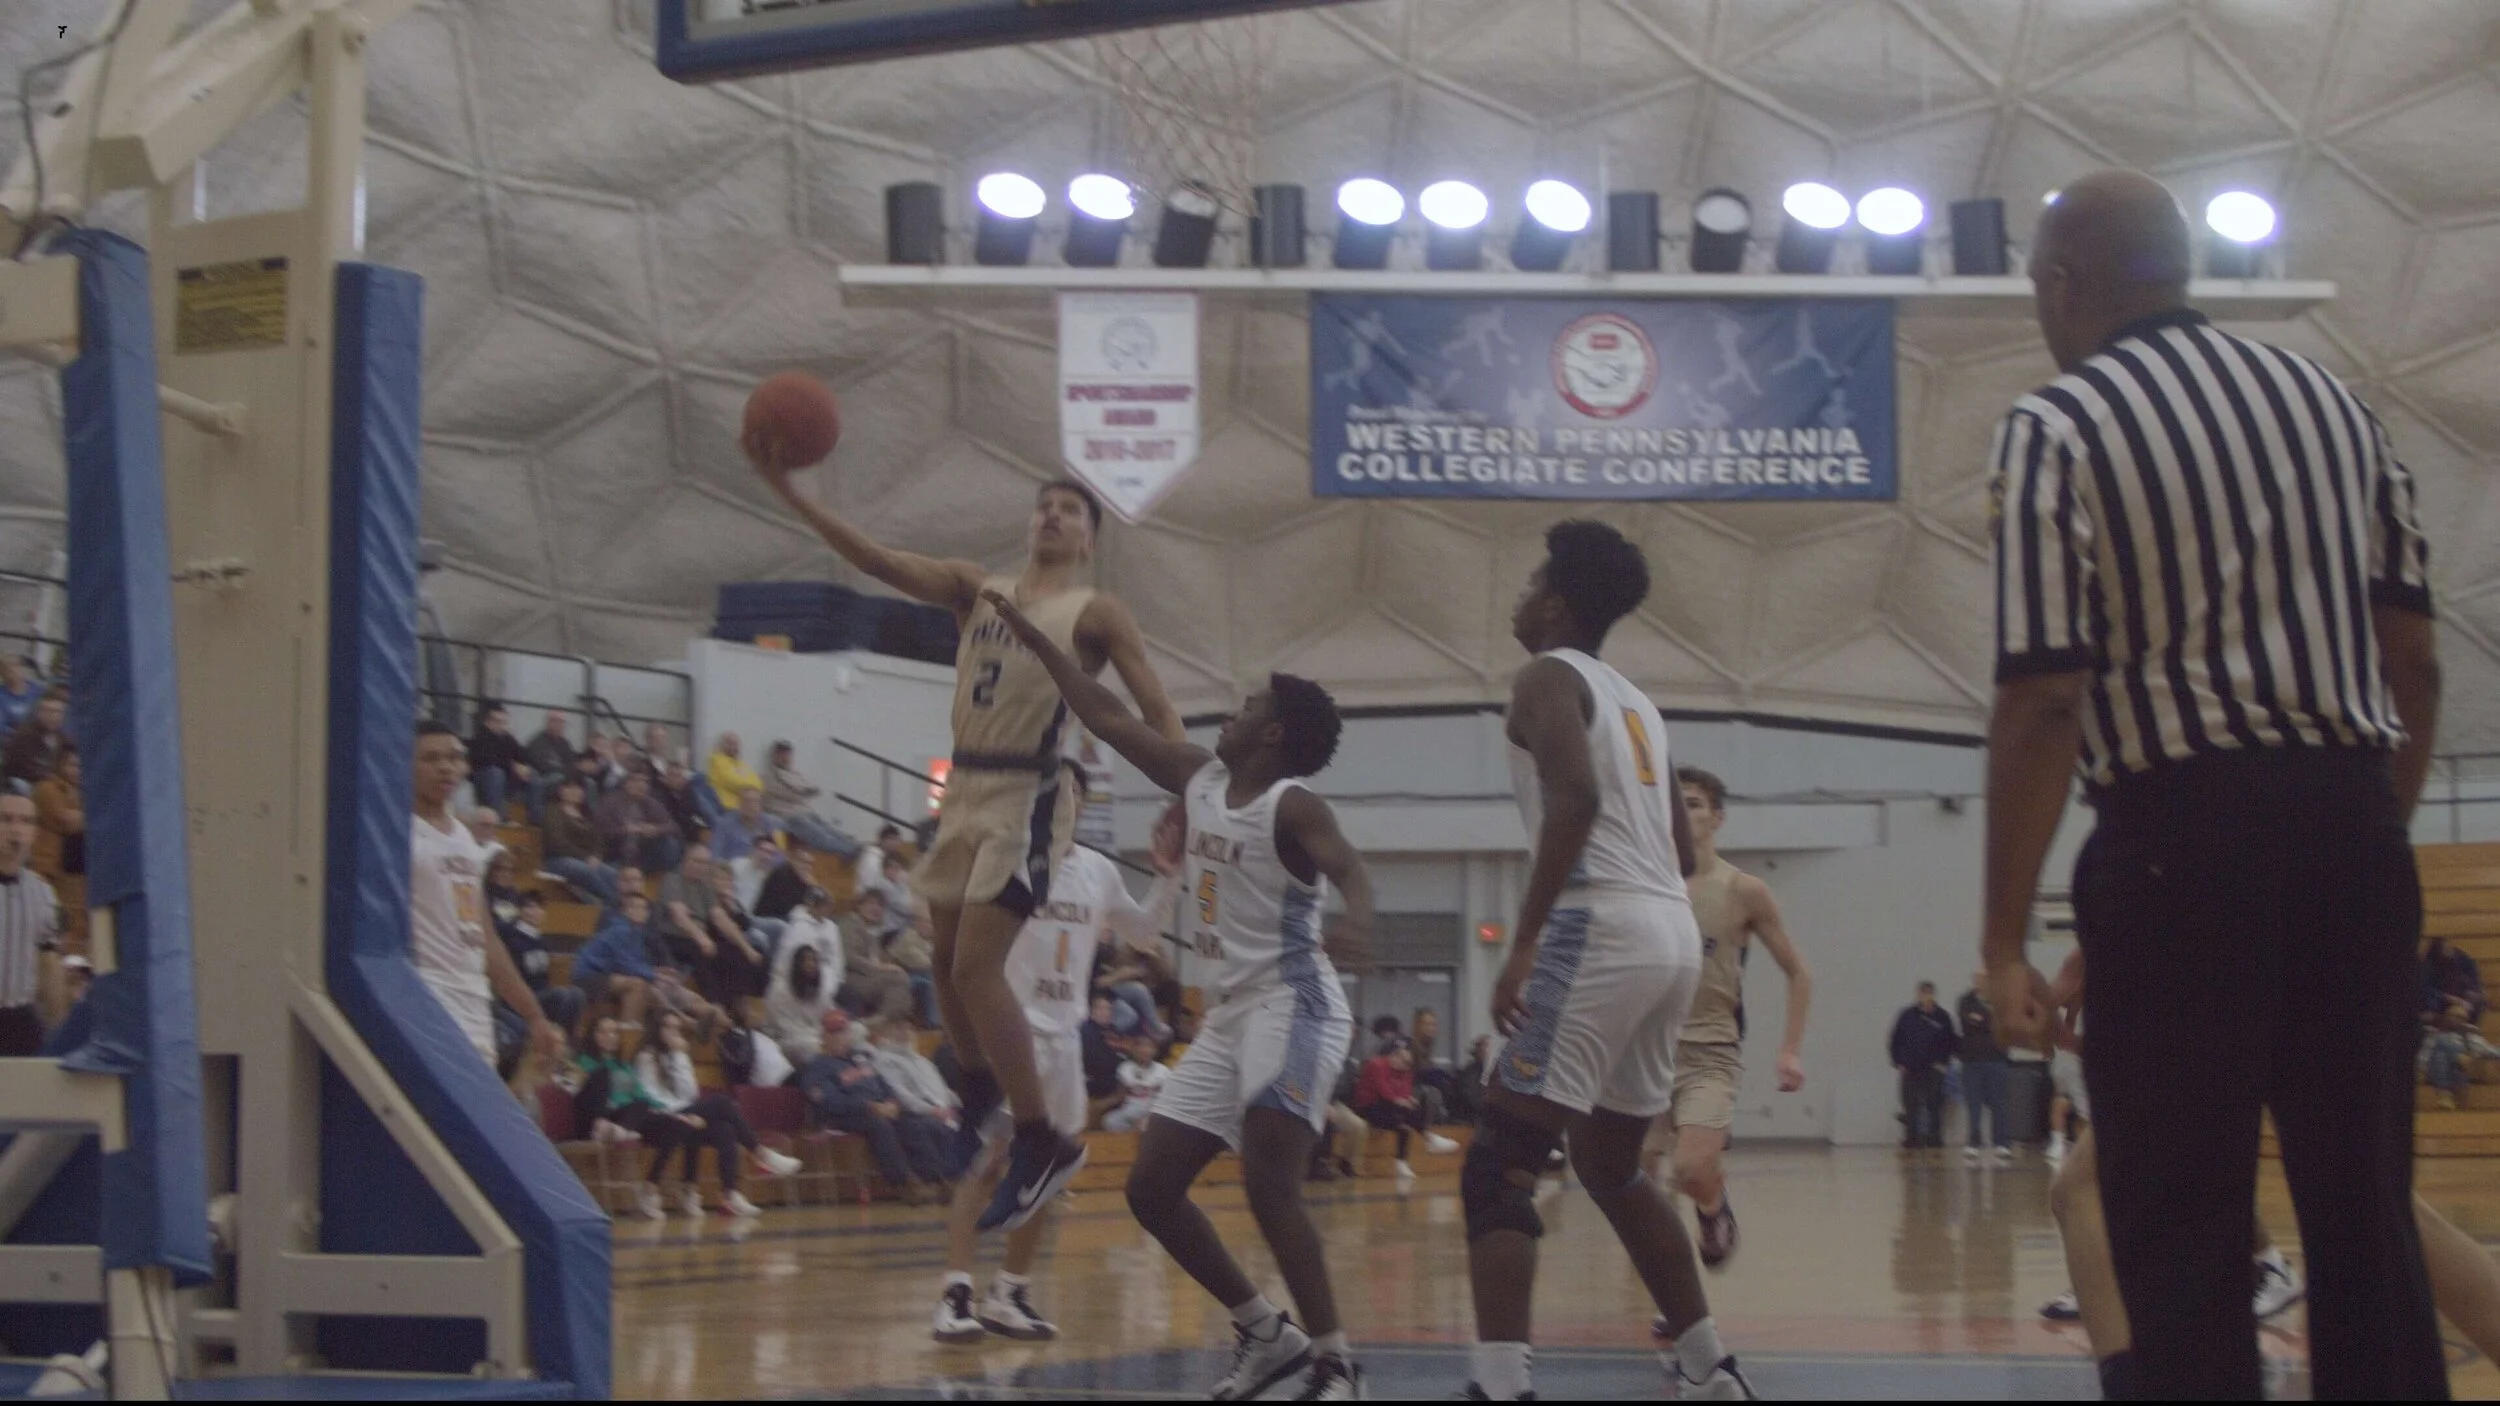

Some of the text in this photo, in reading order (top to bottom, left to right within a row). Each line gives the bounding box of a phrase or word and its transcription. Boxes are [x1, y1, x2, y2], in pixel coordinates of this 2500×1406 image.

[1346, 422, 1863, 455] WESTERN PENNSYLVANIA
[1336, 452, 1872, 485] COLLEGIATE CONFERENCE
[971, 661, 1002, 710] 2
[1198, 869, 1218, 925] 5
[1055, 928, 1070, 974] 1
